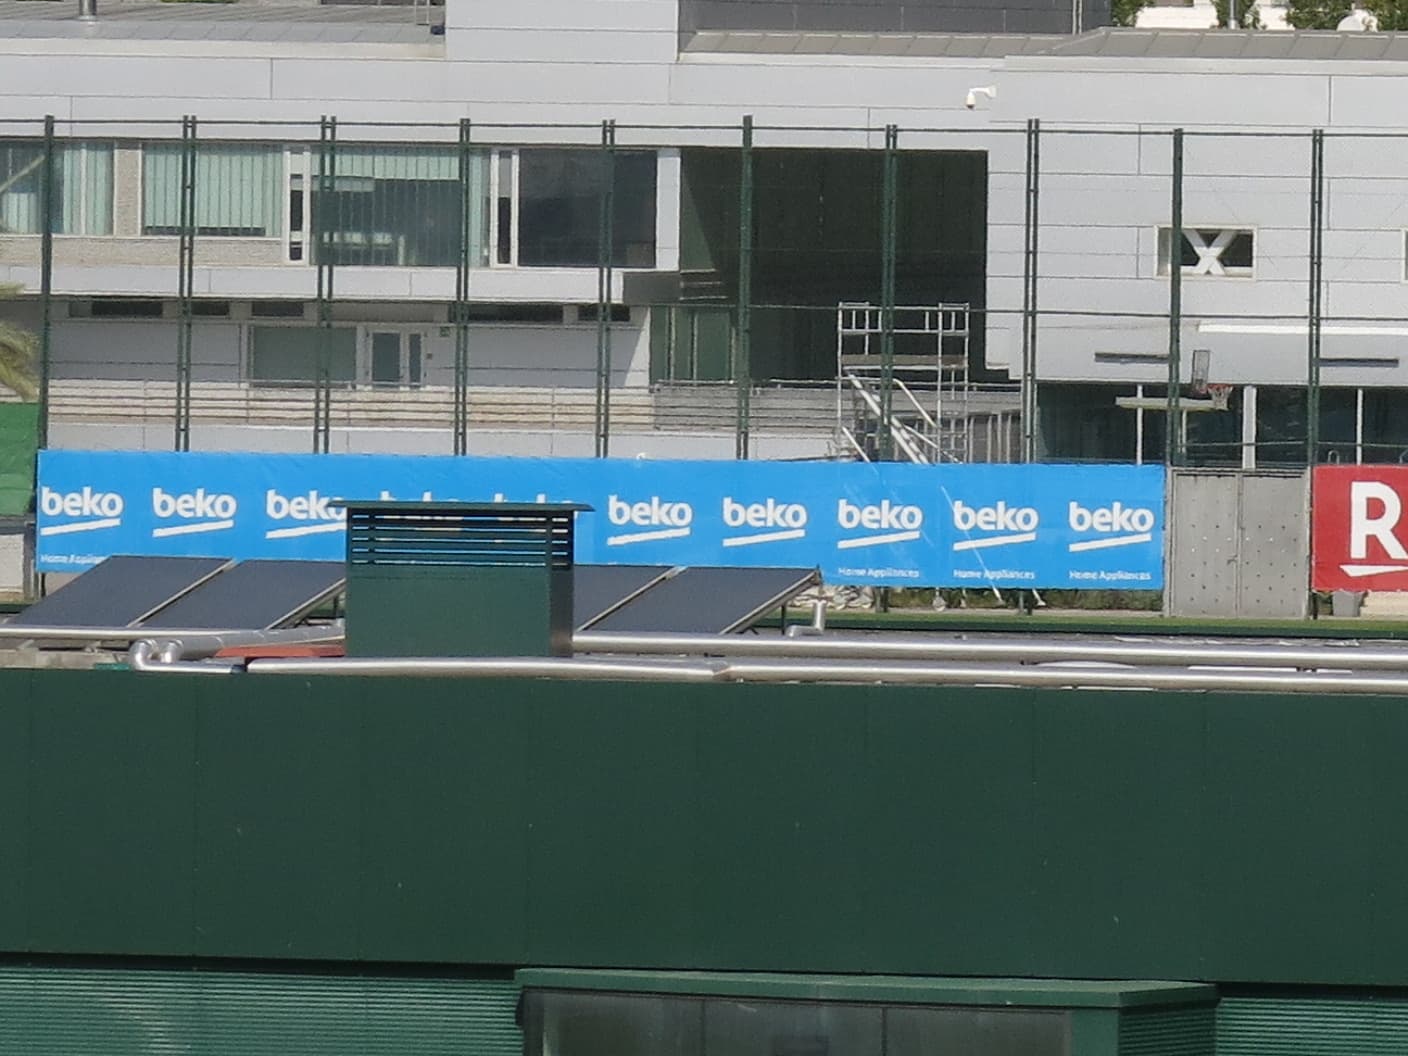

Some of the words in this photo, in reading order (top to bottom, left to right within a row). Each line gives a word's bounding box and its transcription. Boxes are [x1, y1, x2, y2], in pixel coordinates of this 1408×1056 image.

[41, 487, 123, 517] beko
[152, 488, 237, 518] beko
[609, 495, 693, 527] beko
[723, 497, 807, 529] beko
[838, 499, 923, 529] beko
[953, 500, 1039, 531] beko
[1069, 501, 1154, 532] beko
